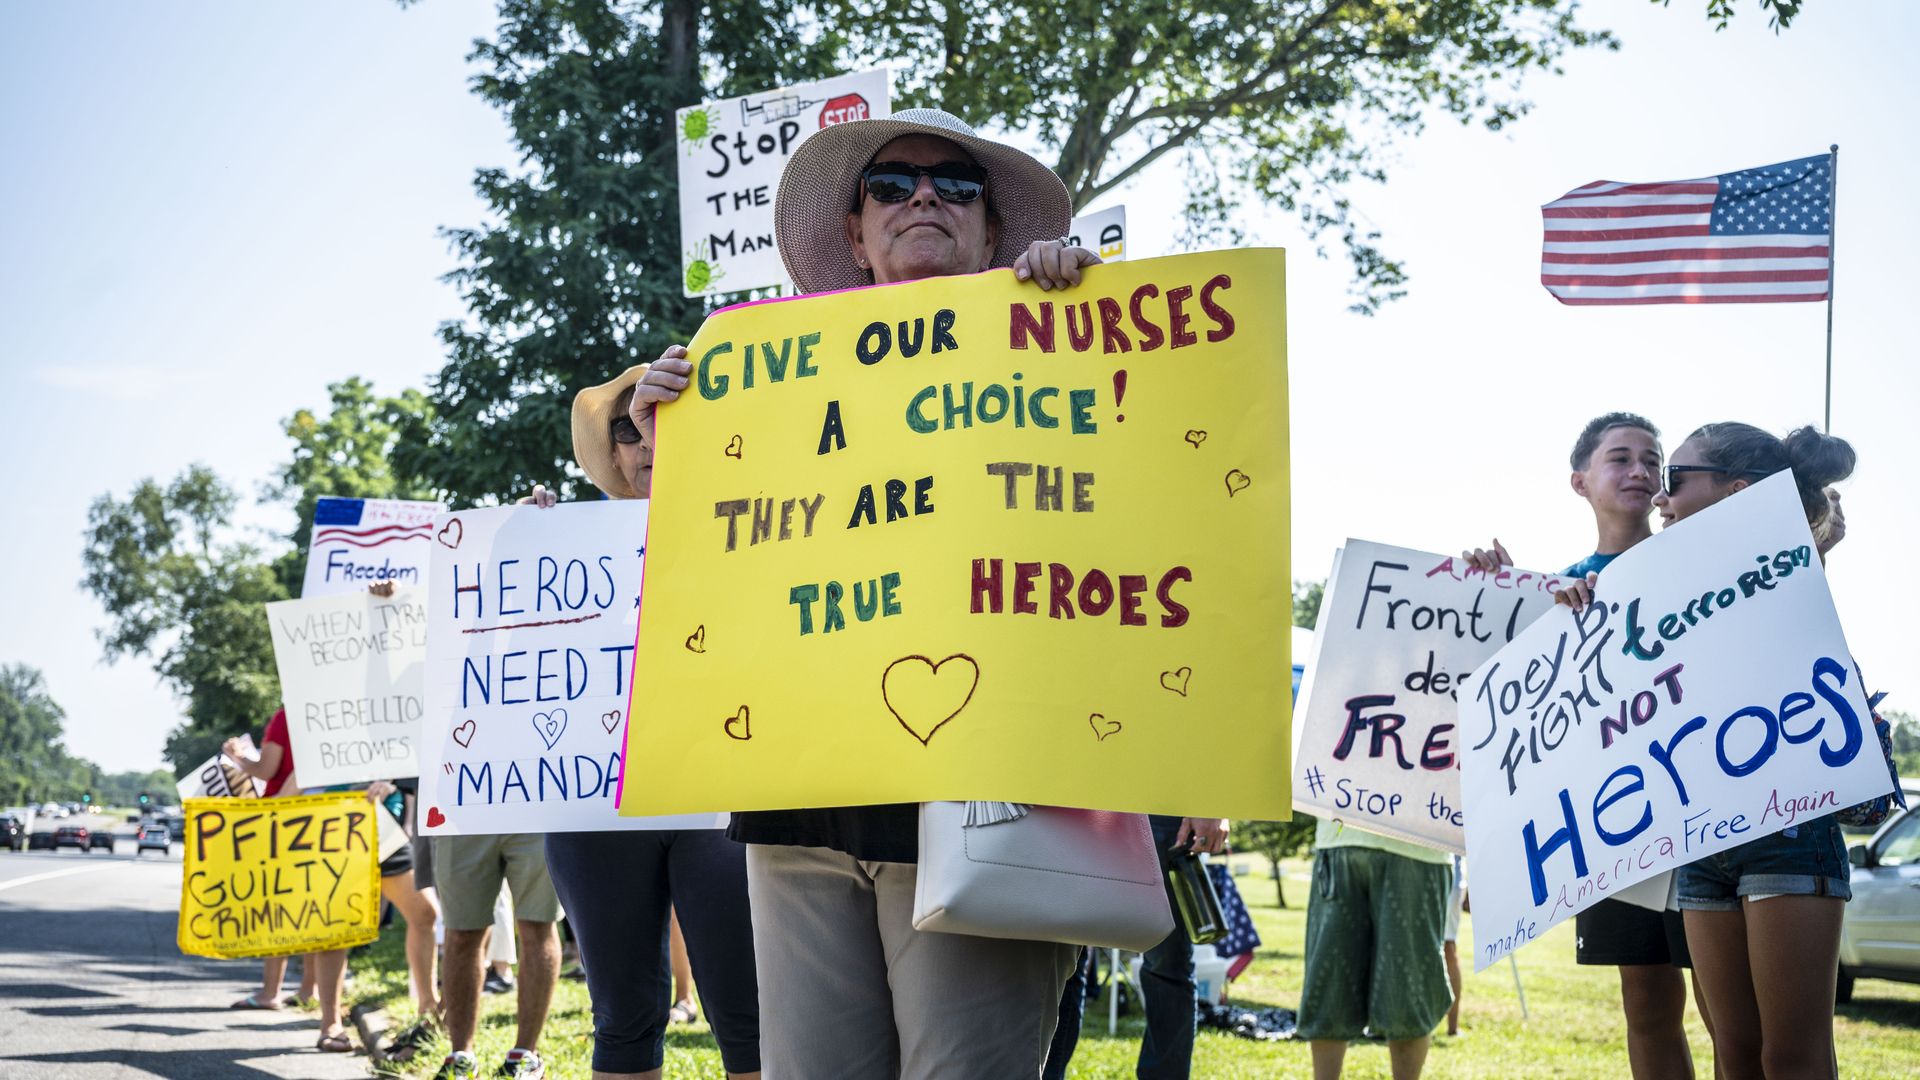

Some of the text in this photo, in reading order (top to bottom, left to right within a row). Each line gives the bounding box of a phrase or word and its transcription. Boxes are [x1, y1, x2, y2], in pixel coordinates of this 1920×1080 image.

[824, 102, 868, 126] STOP
[706, 185, 770, 216] THE
[698, 274, 1236, 401] GIVE OUR NURSES
[817, 400, 847, 455] A
[714, 462, 1095, 553] THEY ARE THE
[454, 556, 615, 618] HEROS
[789, 557, 1193, 636] TRUE HEROES
[1356, 561, 1492, 643] Front
[280, 611, 362, 645] WHEN
[309, 630, 404, 671] BECOMES
[463, 648, 588, 708] NEED
[1473, 632, 1567, 750] Joey
[1599, 663, 1684, 749] NOT
[320, 736, 410, 770] BECOMES
[1333, 695, 1460, 771] FRE
[1426, 792, 1464, 827] the
[1549, 836, 1675, 922] America
[1684, 808, 1751, 853] Free
[1760, 789, 1840, 826] Again
